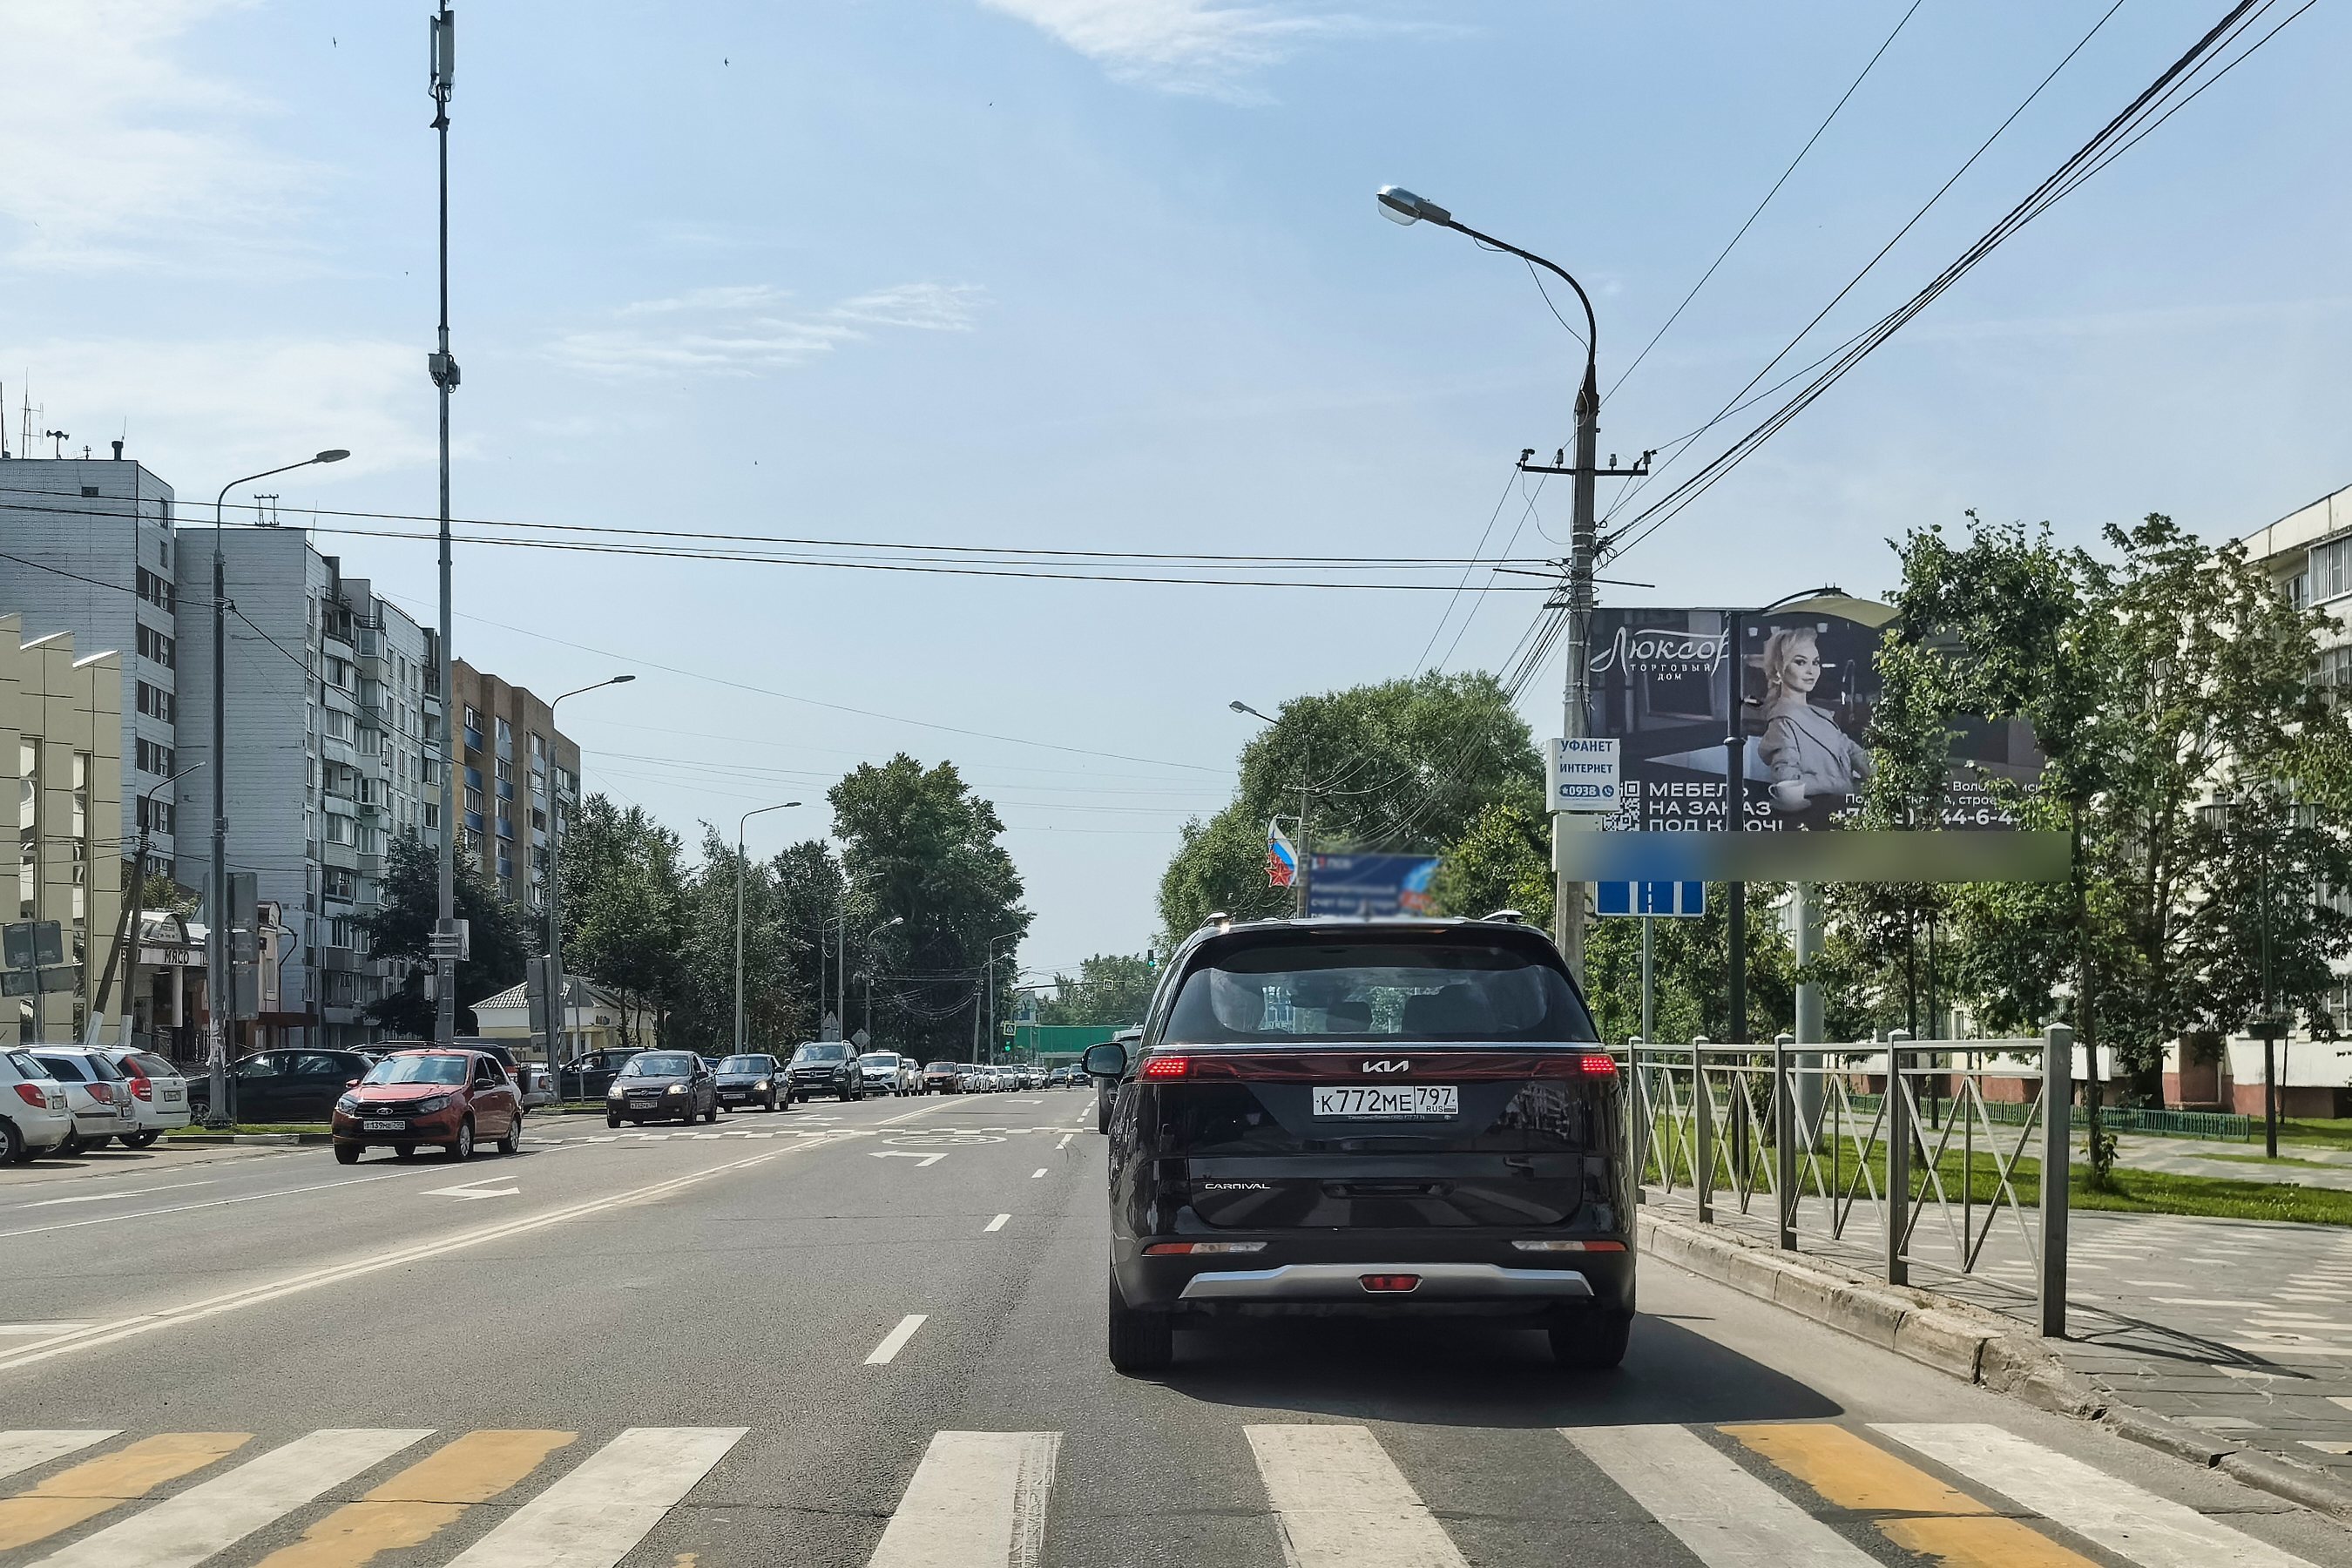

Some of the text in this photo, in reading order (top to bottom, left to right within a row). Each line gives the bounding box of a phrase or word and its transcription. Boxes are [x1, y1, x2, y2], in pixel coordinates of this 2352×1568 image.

[1560, 740, 1613, 752] УФАНЕТ
[1559, 763, 1613, 774] ИНТЕРНЕТ
[1649, 801, 1682, 815] НА
[1649, 819, 1700, 832] ПОД
[164, 950, 190, 964] МЯСО
[1362, 1060, 1409, 1073] KIA
[1416, 1088, 1452, 1105] 797
